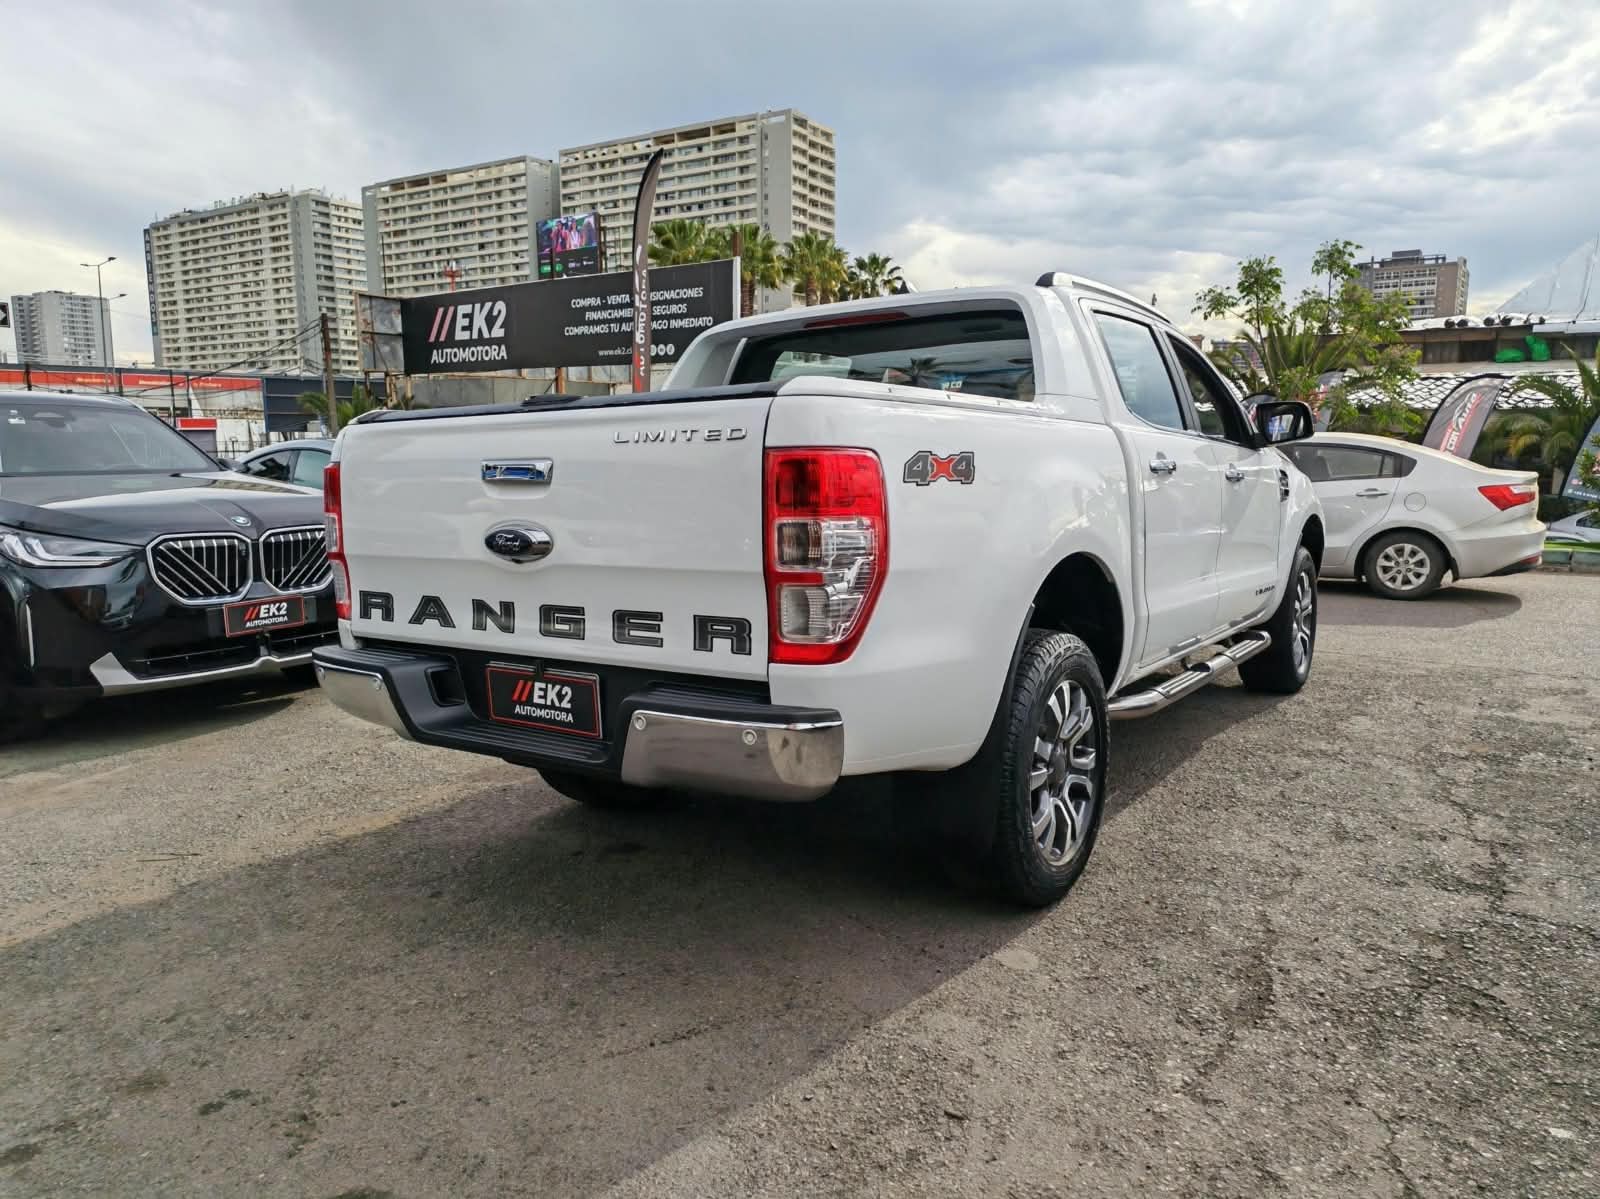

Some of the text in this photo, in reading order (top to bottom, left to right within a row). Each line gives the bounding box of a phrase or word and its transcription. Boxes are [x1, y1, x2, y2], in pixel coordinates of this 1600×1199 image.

[571, 296, 602, 308] COMPRA
[607, 294, 631, 305] VENTA
[650, 287, 704, 301] SIGNACIONES
[585, 303, 688, 320] FINANCIAMIE SEGUROS
[564, 323, 609, 336] COMPRAMOS
[609, 323, 620, 332] TU
[651, 319, 668, 330] AGO
[669, 316, 713, 329] INMEDIATO
[430, 344, 507, 365] AUTOMOTORA
[613, 428, 747, 444] LIMITED
[495, 533, 520, 545] Ford
[245, 615, 288, 628] AUTOMOTORA
[358, 589, 752, 656] RANGER
[514, 704, 574, 723] AUTOMOTORA
